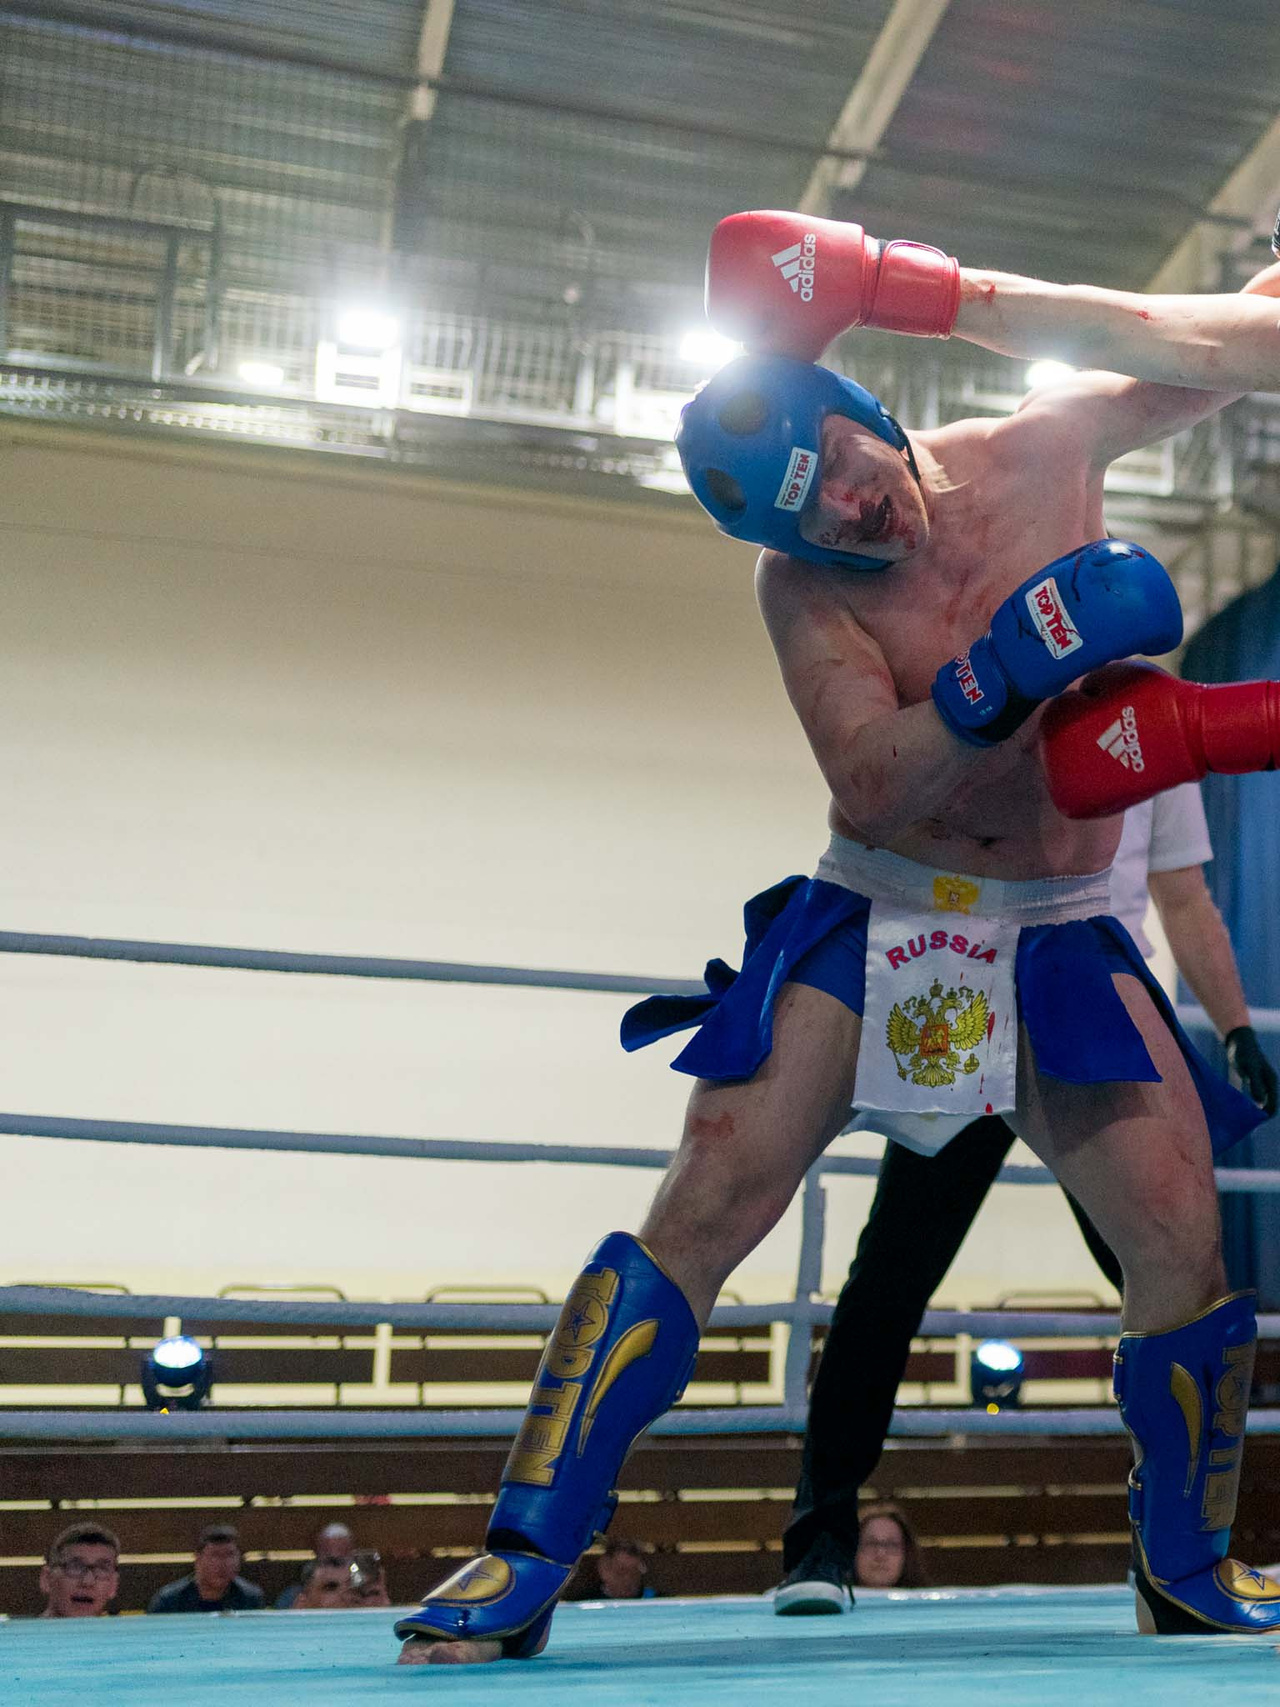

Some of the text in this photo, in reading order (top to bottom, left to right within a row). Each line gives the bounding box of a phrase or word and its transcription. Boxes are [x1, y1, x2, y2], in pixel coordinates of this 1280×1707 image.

[798, 233, 816, 302] adidas
[784, 482, 801, 507] TOP
[794, 453, 810, 480] TEN
[1034, 585, 1054, 616] TOP
[1045, 611, 1073, 650] TEN
[955, 659, 985, 705] TEN
[1122, 706, 1145, 773] adidas
[502, 1268, 620, 1487] TOP TEN
